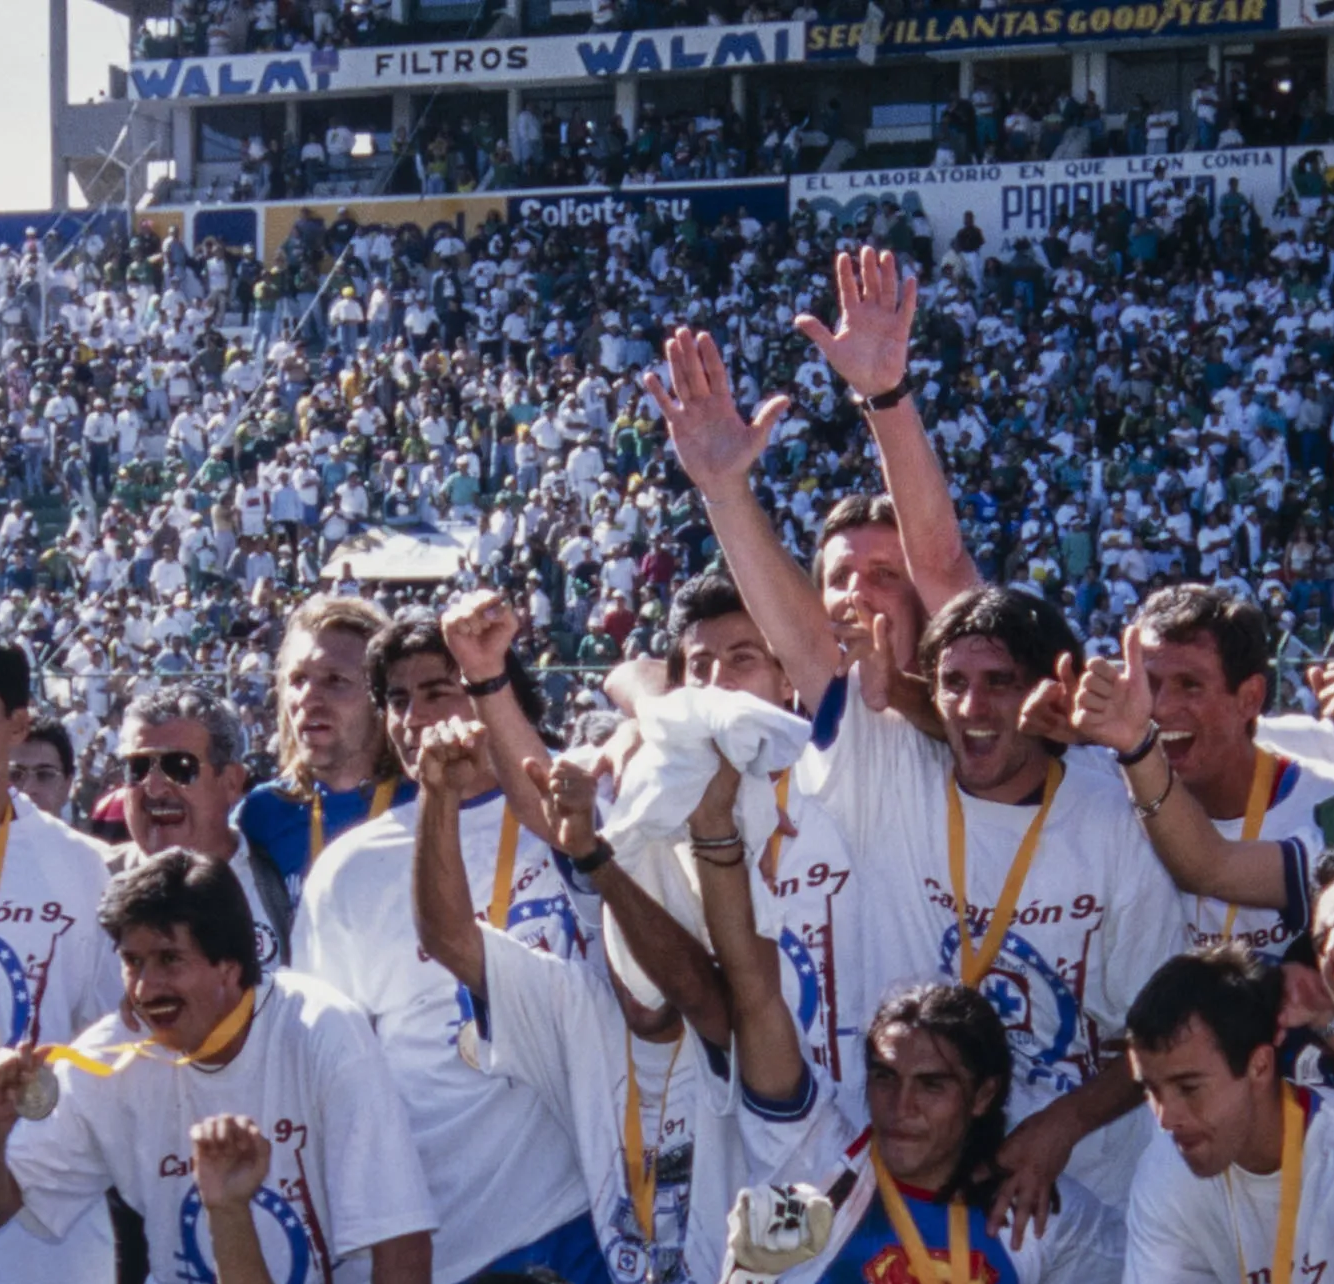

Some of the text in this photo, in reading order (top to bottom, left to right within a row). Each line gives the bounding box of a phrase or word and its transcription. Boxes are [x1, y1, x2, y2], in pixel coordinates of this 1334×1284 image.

[1067, 0, 1264, 35] GOODYEAR
[376, 45, 528, 77] FILTROS
[576, 29, 790, 77] WALMI
[806, 175, 833, 190] EL
[849, 165, 1001, 188] LABORATORIO
[1019, 164, 1045, 179] EN
[1065, 160, 1105, 176] QUE
[1202, 151, 1273, 170] CONFIA
[520, 196, 627, 228] Solicit
[806, 862, 850, 895] 97
[40, 901, 76, 936] 97
[275, 1118, 307, 1149] 97
